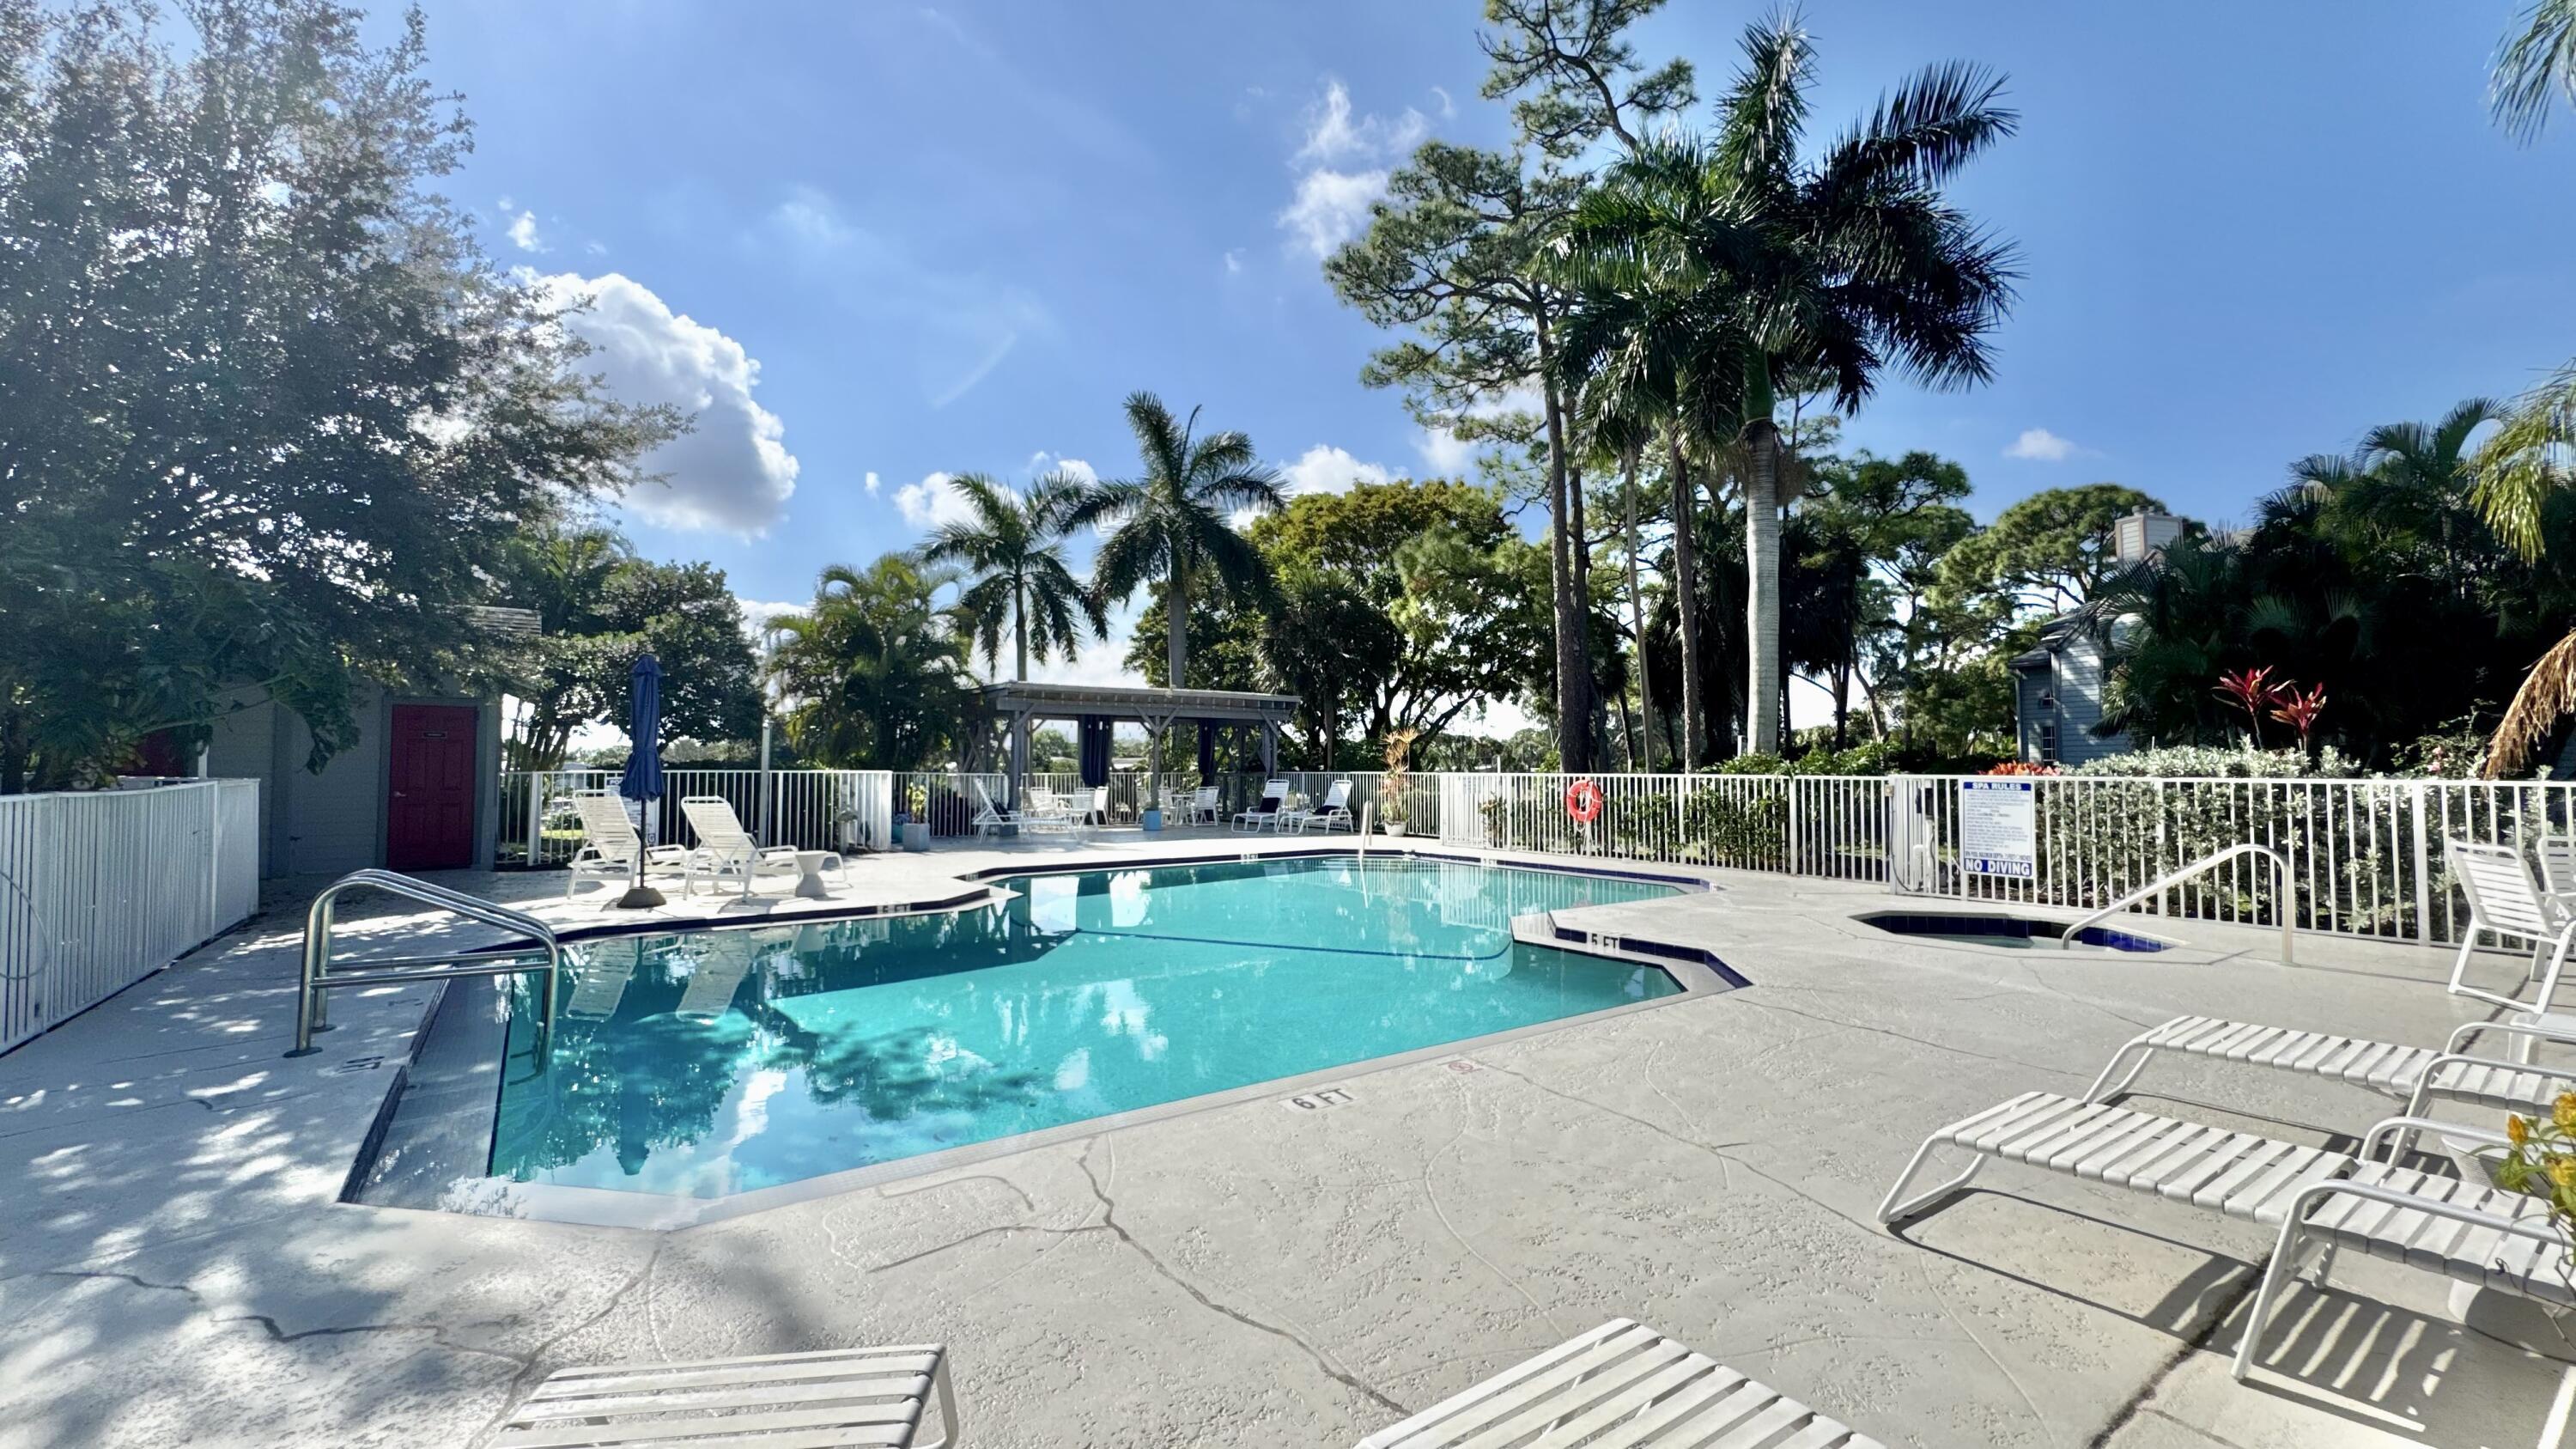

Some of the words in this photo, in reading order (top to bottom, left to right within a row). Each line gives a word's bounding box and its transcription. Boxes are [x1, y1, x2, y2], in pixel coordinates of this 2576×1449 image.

[1965, 859, 1983, 871] NO
[1988, 860, 2030, 875] DIVING
[1591, 933, 1598, 945] 5
[1603, 935, 1618, 948] FT
[1291, 1098, 1316, 1109] 6
[1314, 1087, 1354, 1105] FT
